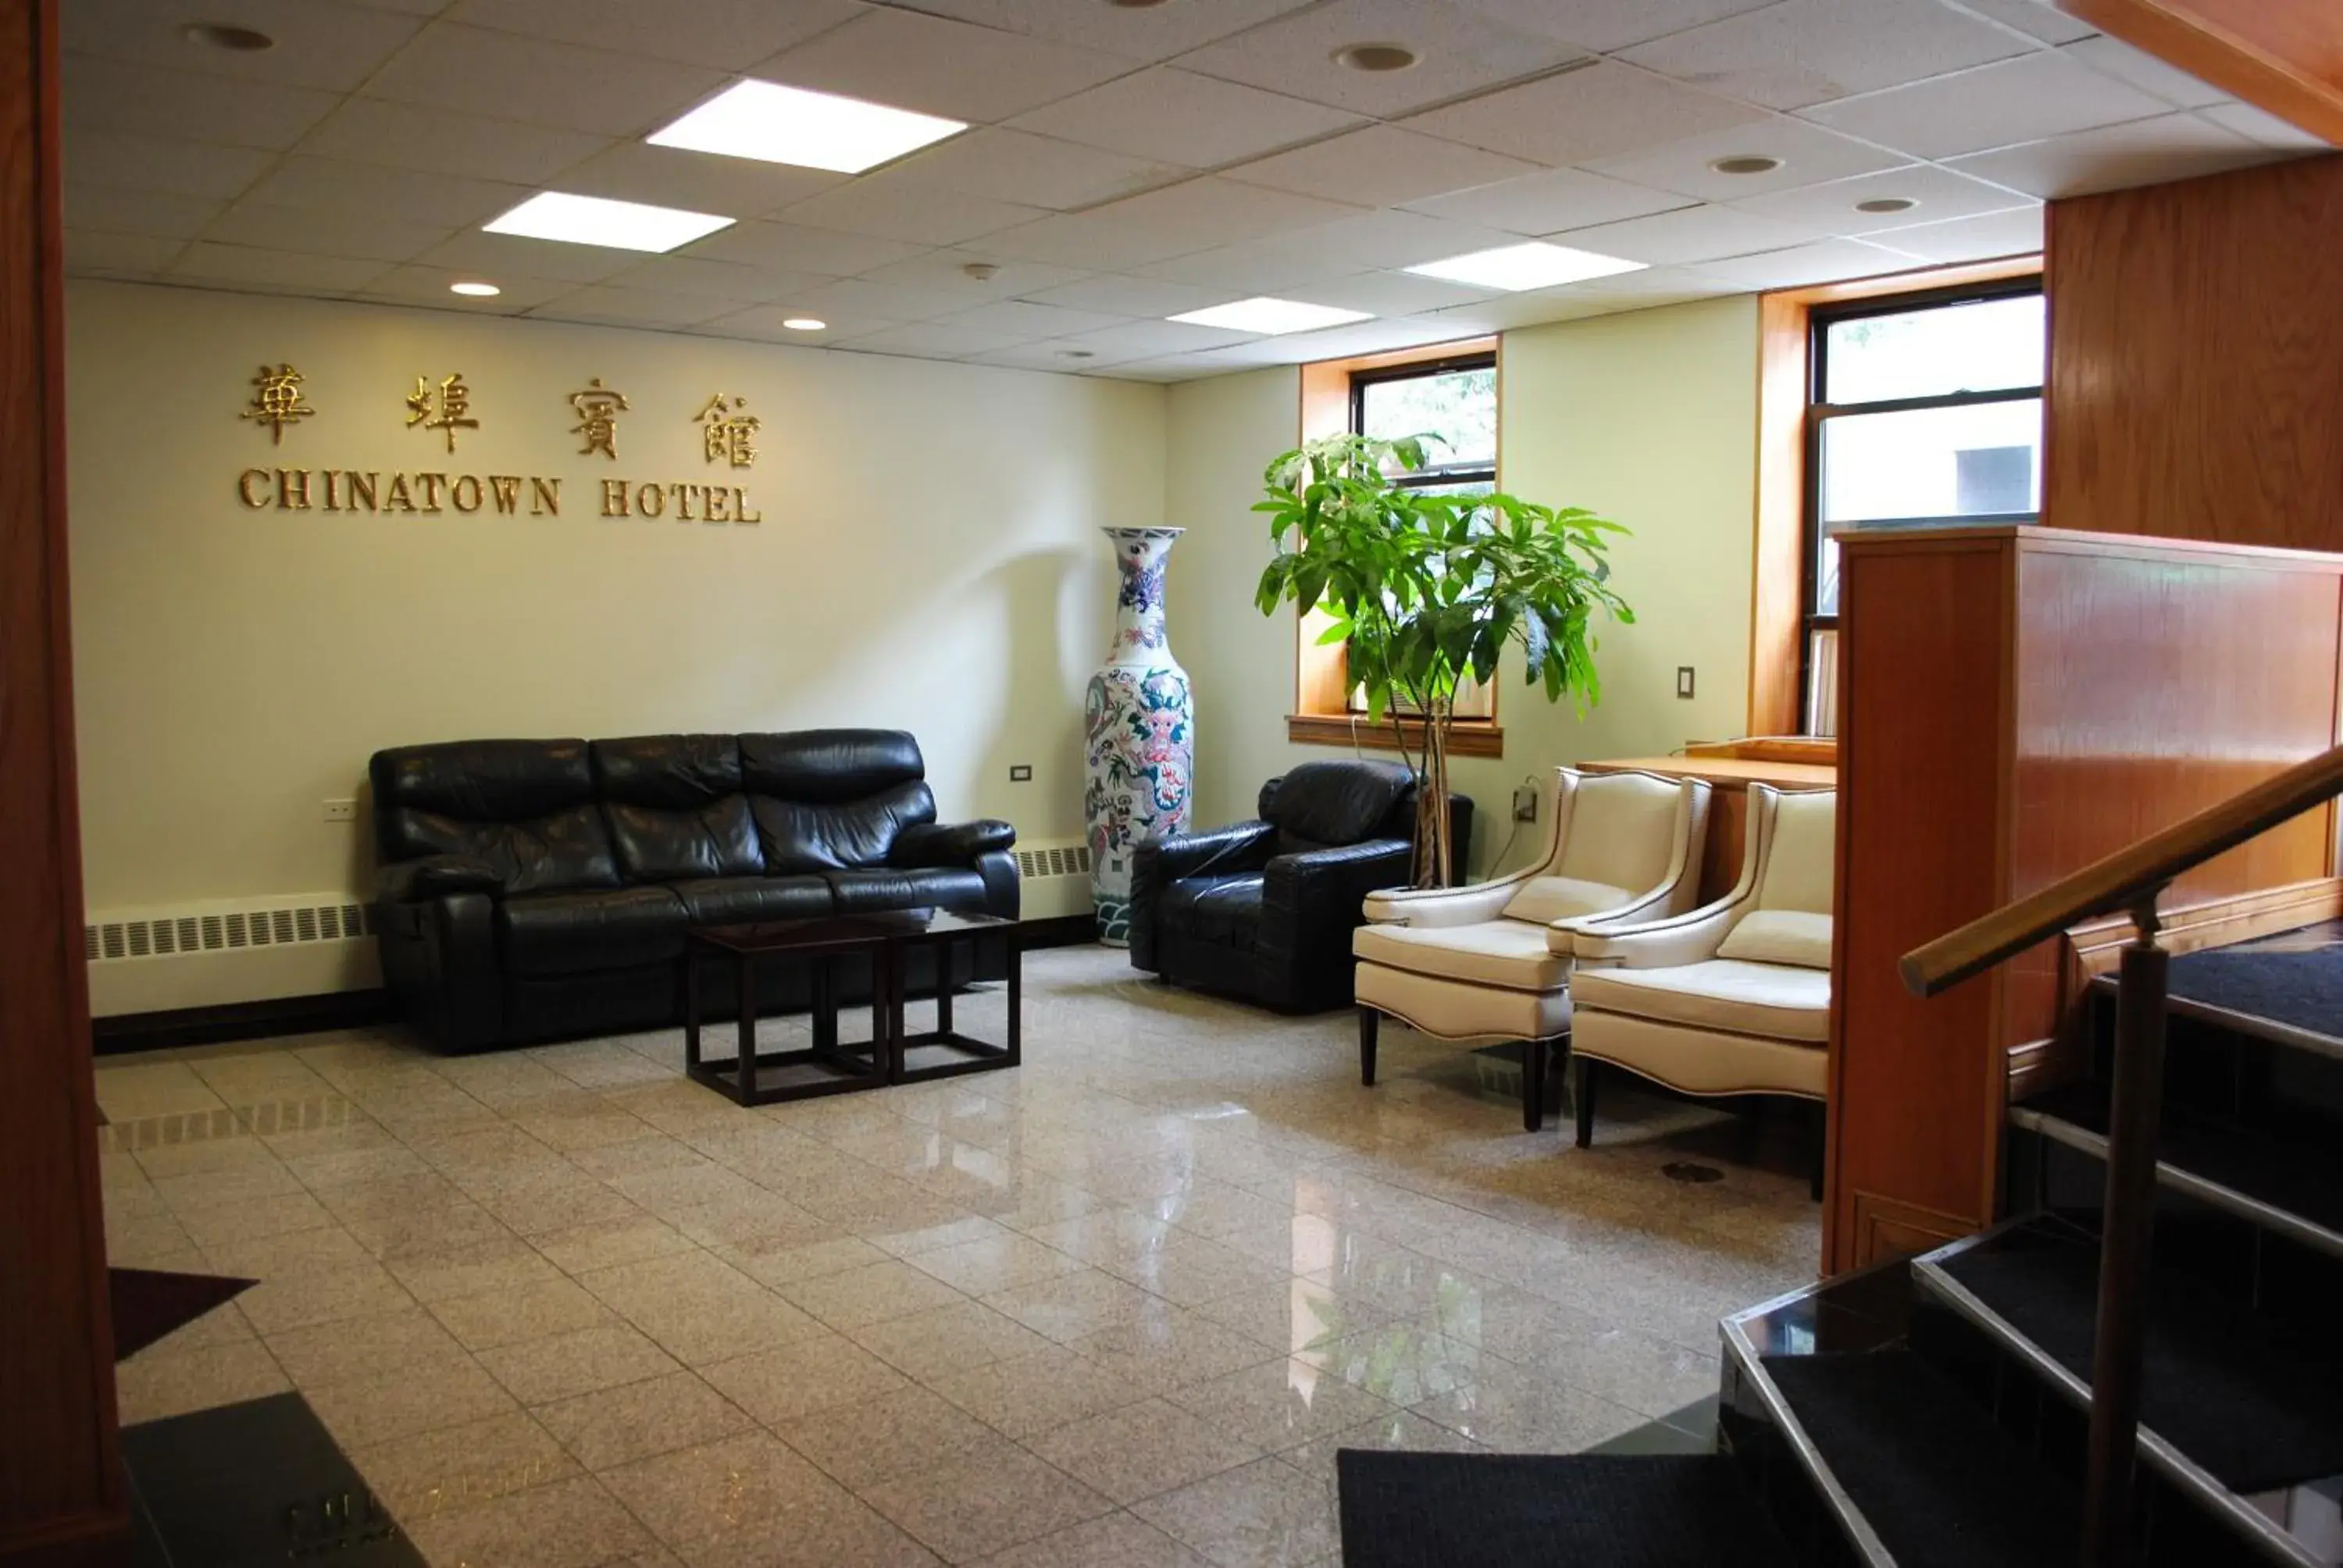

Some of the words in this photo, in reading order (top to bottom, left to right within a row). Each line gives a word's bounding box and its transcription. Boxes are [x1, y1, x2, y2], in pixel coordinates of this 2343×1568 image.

[238, 362, 763, 469] 華埠賓館
[238, 469, 562, 517] CHINATOWN
[601, 479, 761, 523] HOTEL
